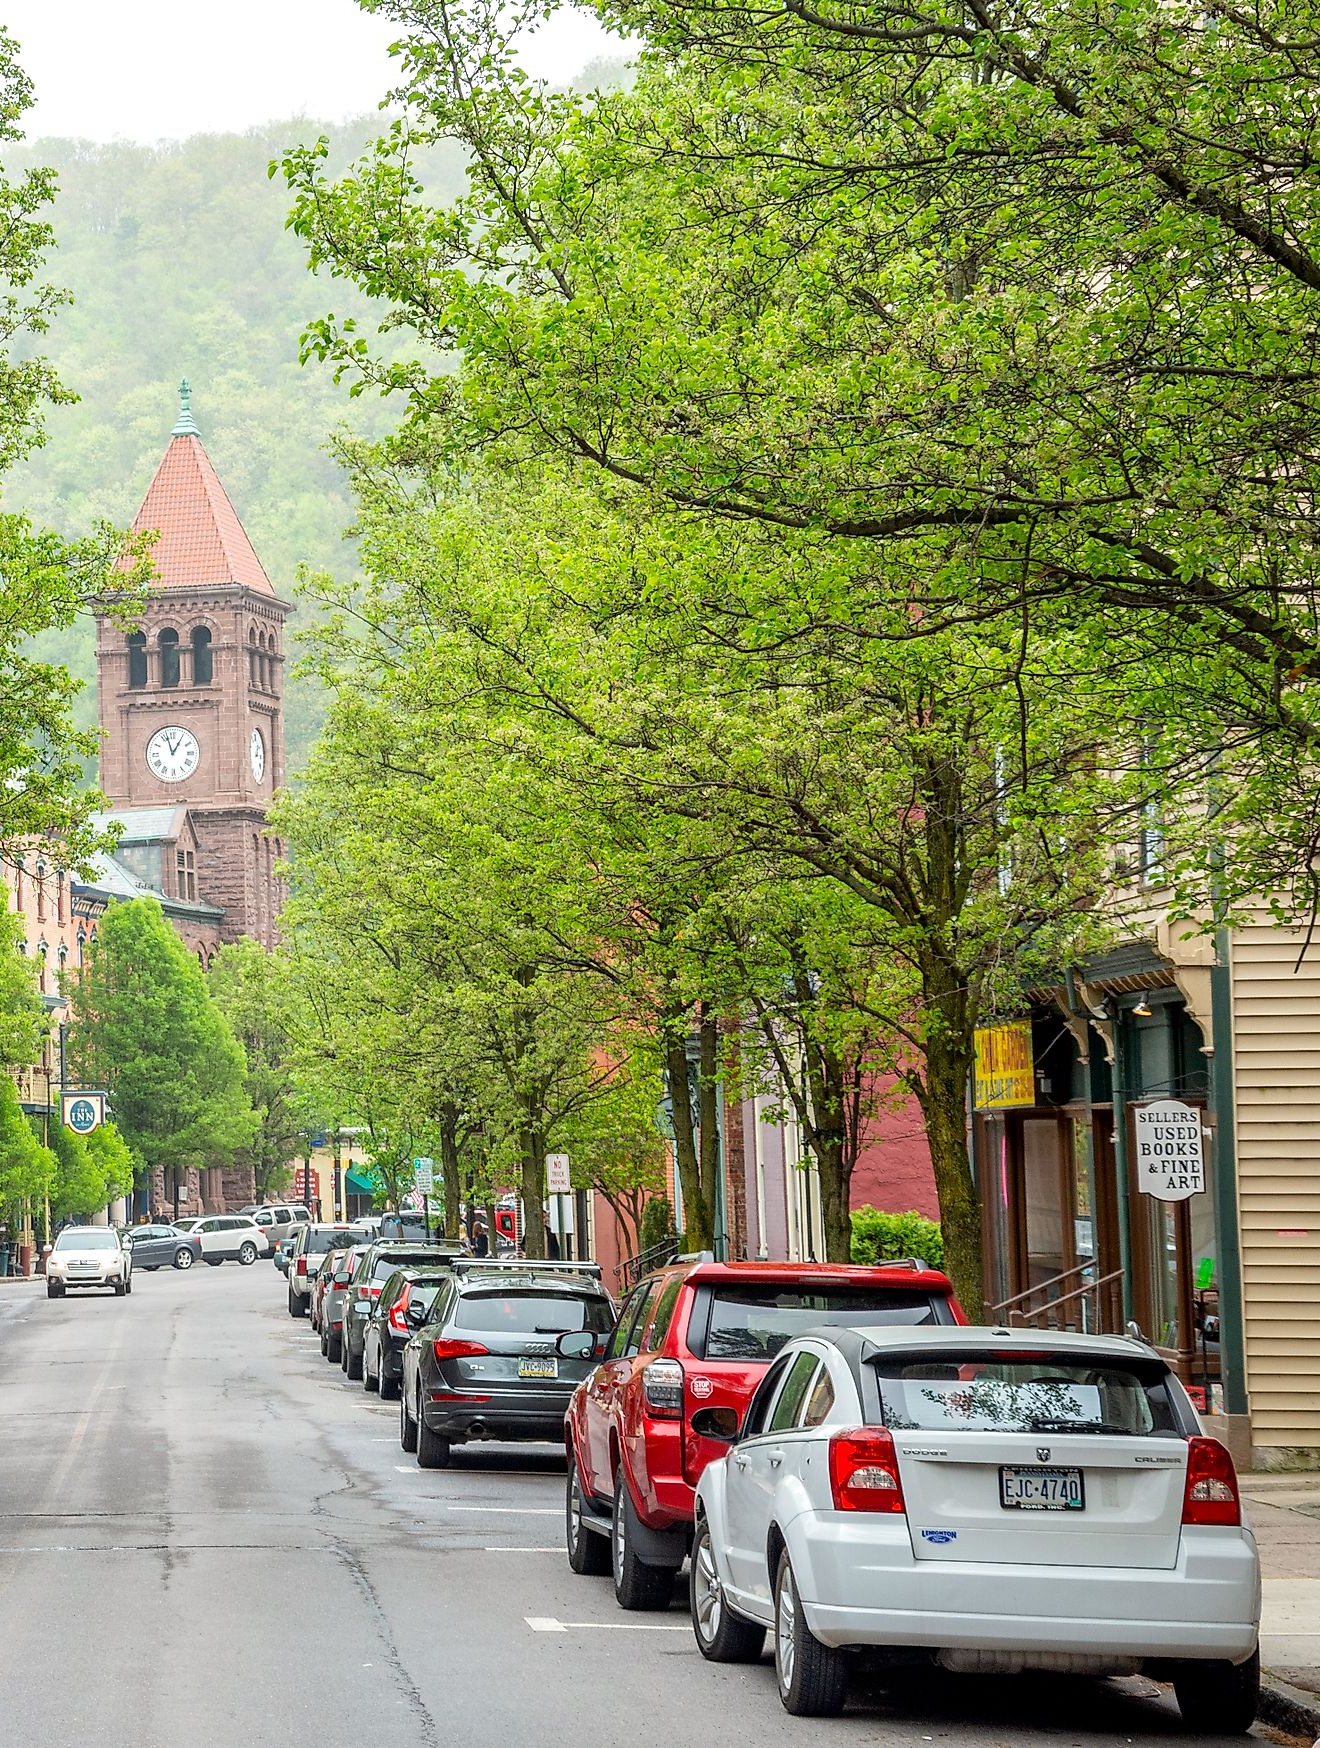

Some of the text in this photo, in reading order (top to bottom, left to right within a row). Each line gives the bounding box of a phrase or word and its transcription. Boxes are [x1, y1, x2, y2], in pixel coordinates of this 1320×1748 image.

[71, 1112, 94, 1122] INN
[1139, 1112, 1198, 1123] SELLERS
[1154, 1127, 1198, 1141] USED
[1141, 1143, 1199, 1156] BOOKS
[553, 1160, 562, 1169] NO
[1148, 1160, 1200, 1174] & FINE
[1166, 1176, 1201, 1189] ART
[694, 1380, 710, 1388] STOP
[902, 1447, 948, 1456] DODGE
